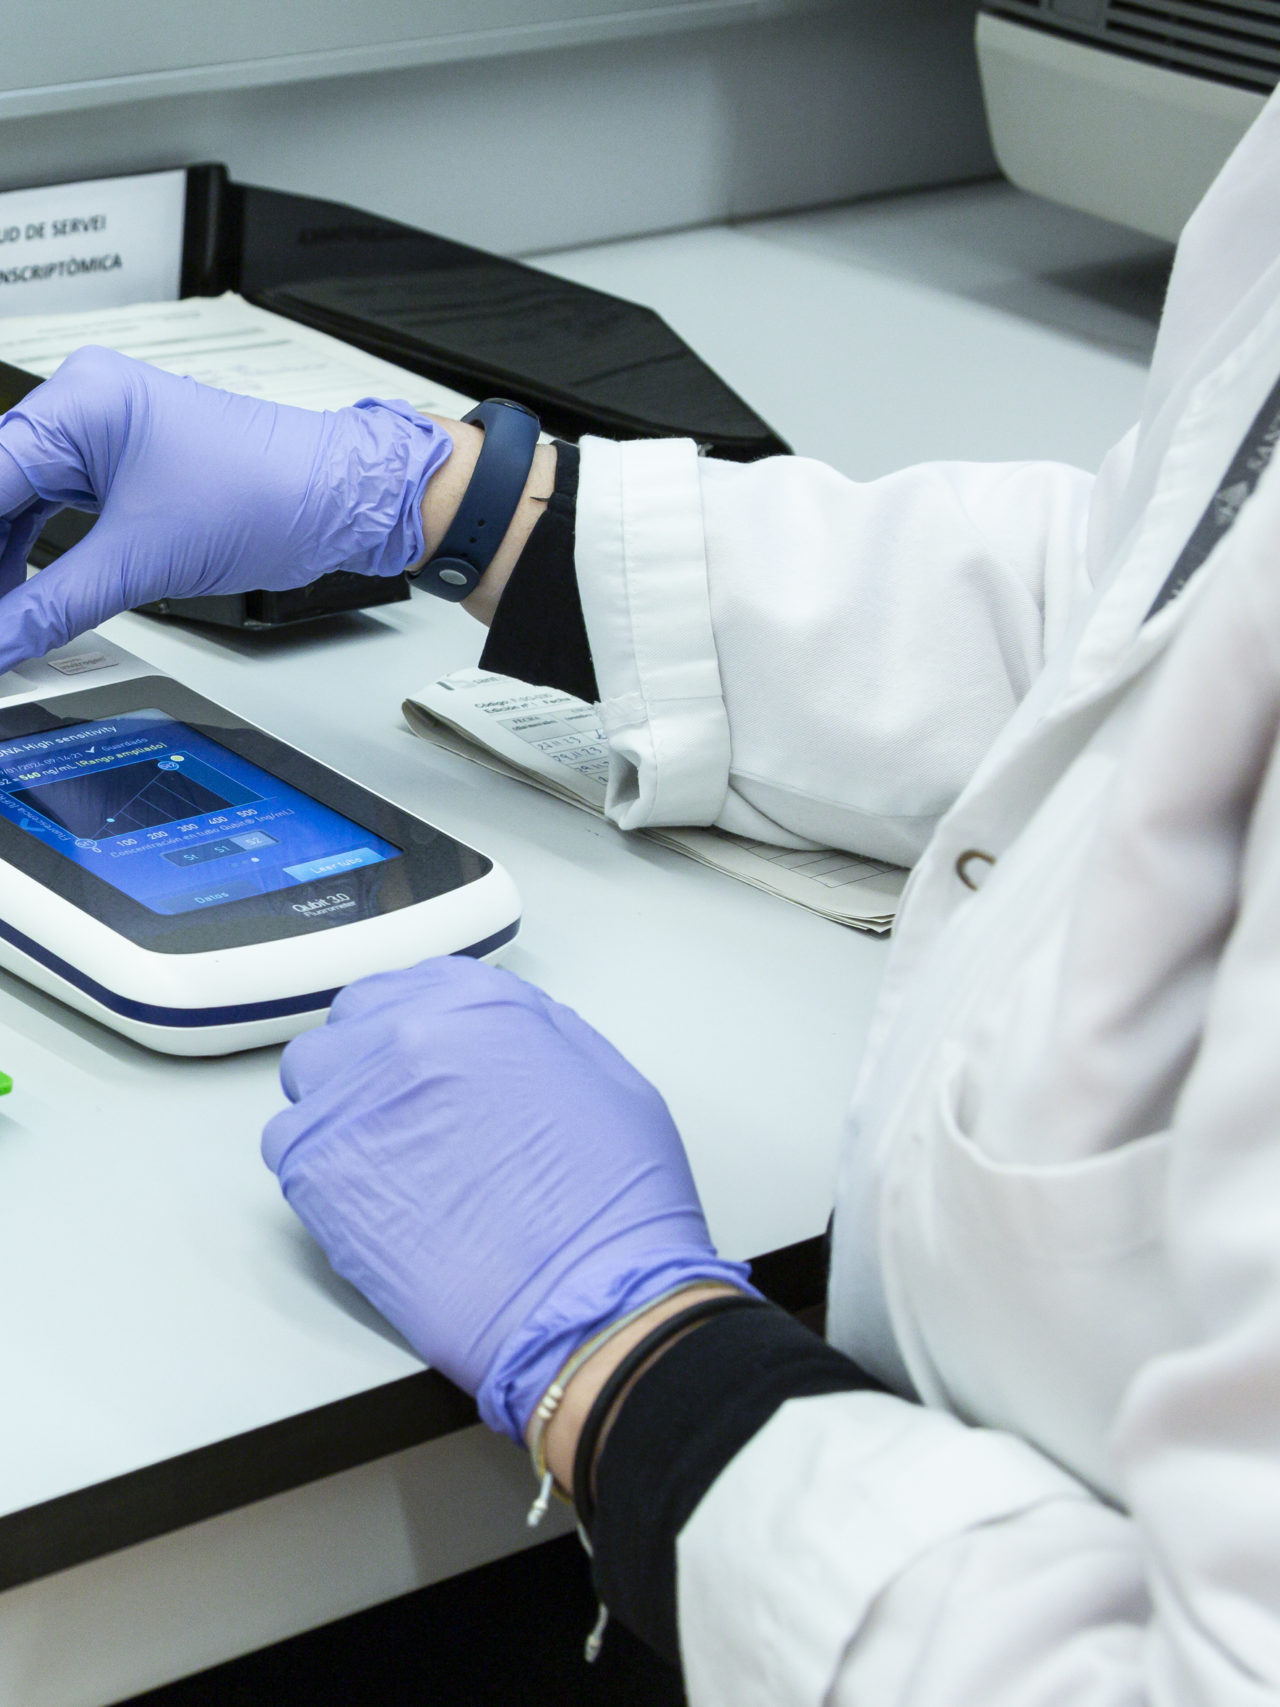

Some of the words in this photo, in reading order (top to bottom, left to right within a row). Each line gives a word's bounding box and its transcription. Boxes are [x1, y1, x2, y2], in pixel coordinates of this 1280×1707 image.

[24, 221, 48, 241] DE
[51, 214, 107, 237] SERVEI
[24, 737, 55, 753] High
[56, 724, 118, 744] sensitivity
[101, 737, 148, 752] Guardado
[19, 771, 41, 781] 560
[42, 763, 77, 776] ng/mL
[115, 742, 168, 757] ampliado)
[116, 838, 138, 847] 100
[146, 830, 168, 840] 200
[177, 823, 199, 832] 300
[208, 815, 228, 825] 400
[236, 808, 258, 817] 500
[196, 827, 220, 836] tubo
[245, 837, 262, 846] S2
[310, 863, 337, 874] Leer
[194, 890, 230, 904] Datos
[292, 897, 331, 913] Qubit
[303, 900, 356, 918] Fluorometer
